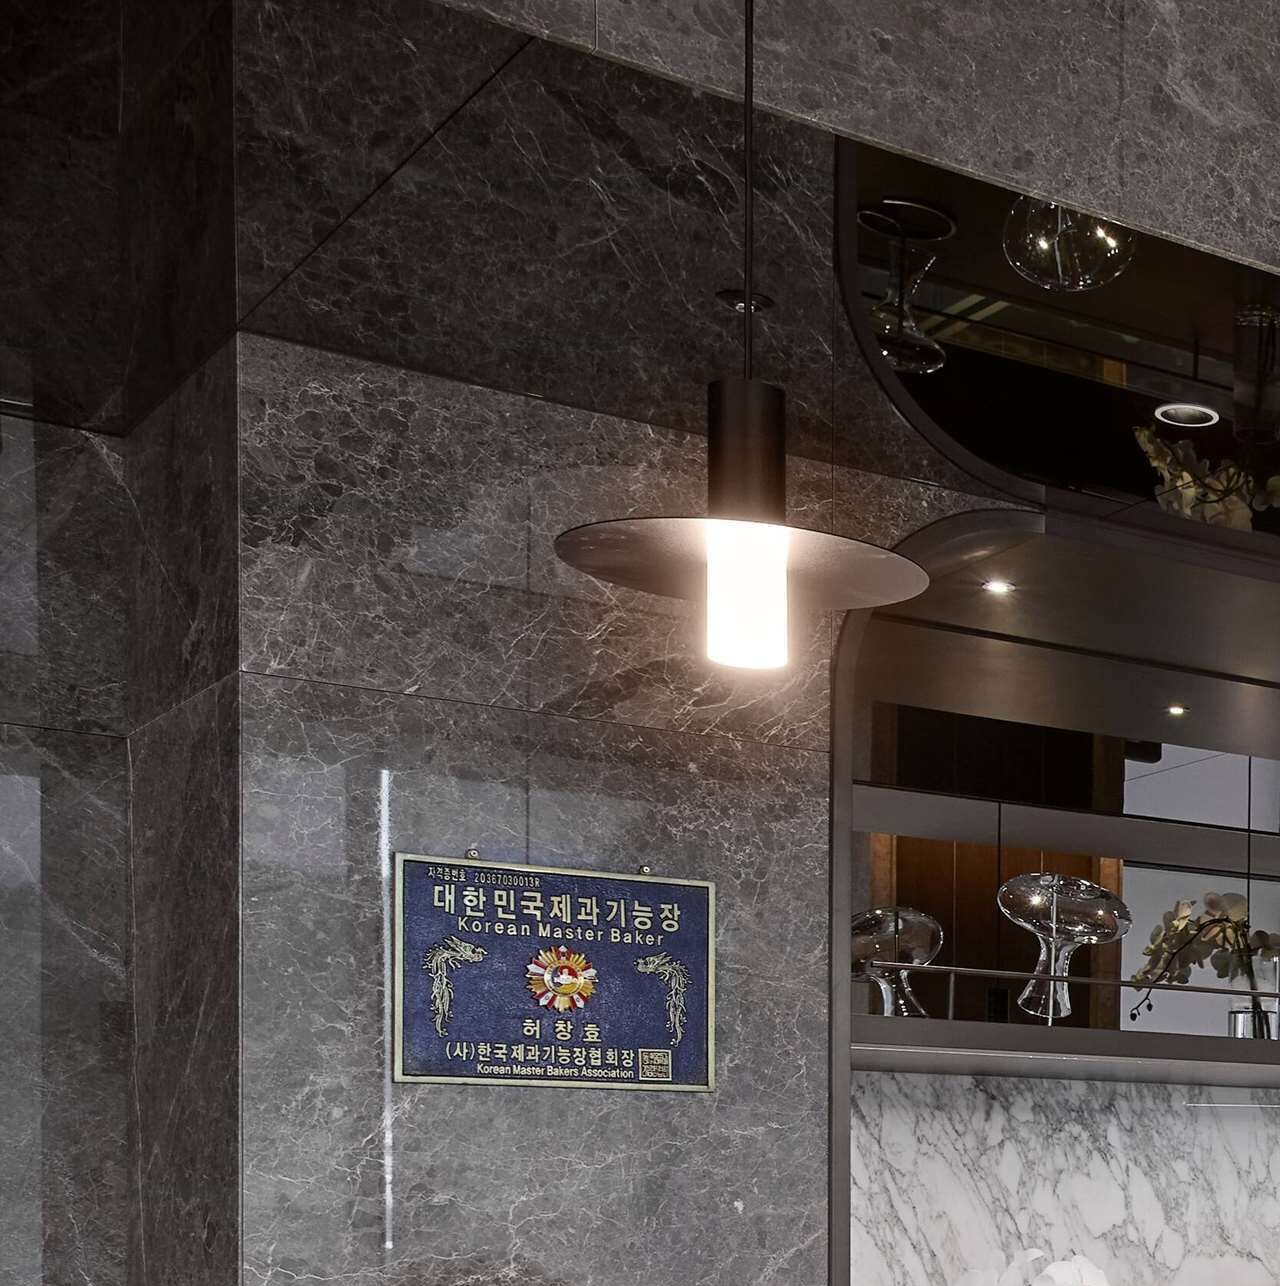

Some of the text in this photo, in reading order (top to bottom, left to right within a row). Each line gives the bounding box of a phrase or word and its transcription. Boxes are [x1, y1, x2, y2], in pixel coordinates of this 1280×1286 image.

[458, 916, 664, 946] Korean Master Baker
[477, 1063, 635, 1079] Korean Master Bakers Association
